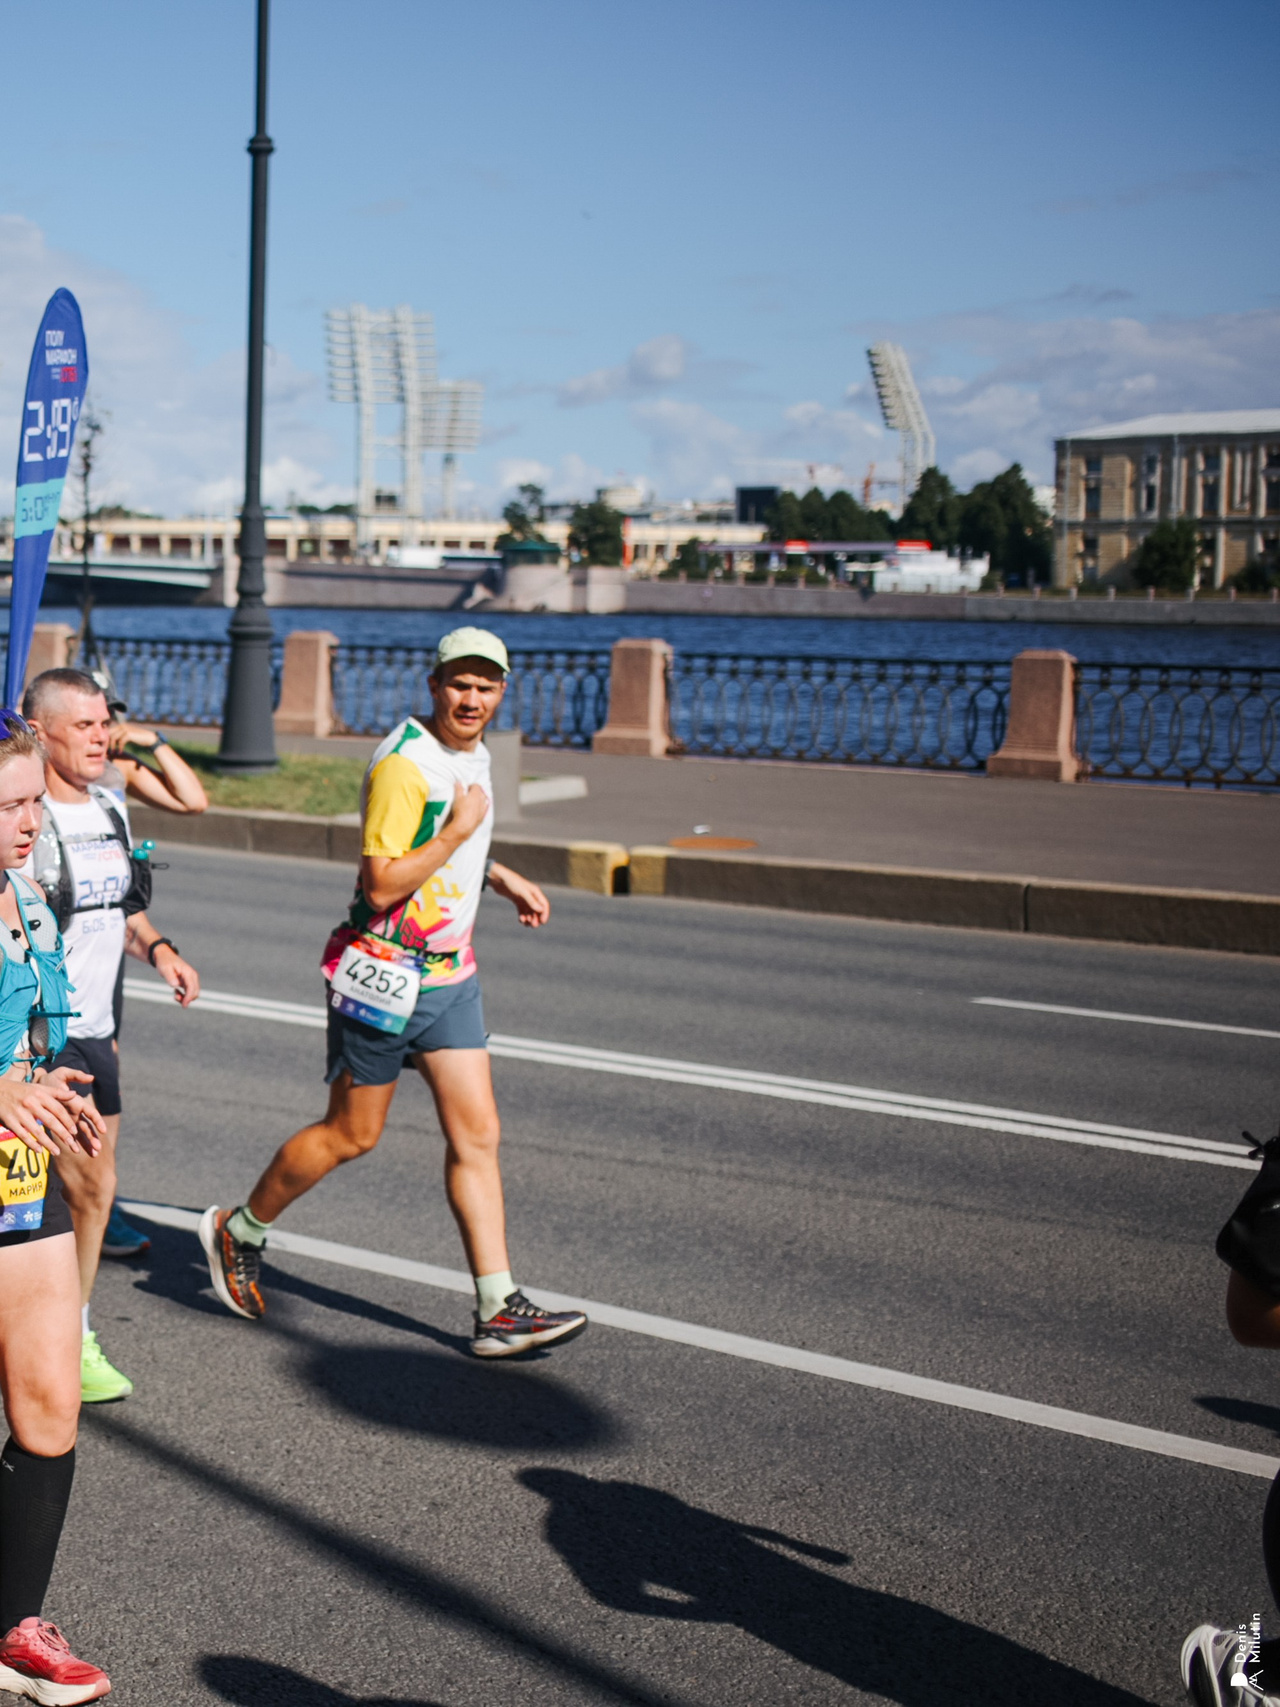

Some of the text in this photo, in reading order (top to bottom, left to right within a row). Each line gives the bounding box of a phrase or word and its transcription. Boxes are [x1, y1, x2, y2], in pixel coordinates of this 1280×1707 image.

[345, 958, 408, 1000] 4252
[331, 991, 343, 1008] B
[9, 1181, 44, 1198] МАРИЯ
